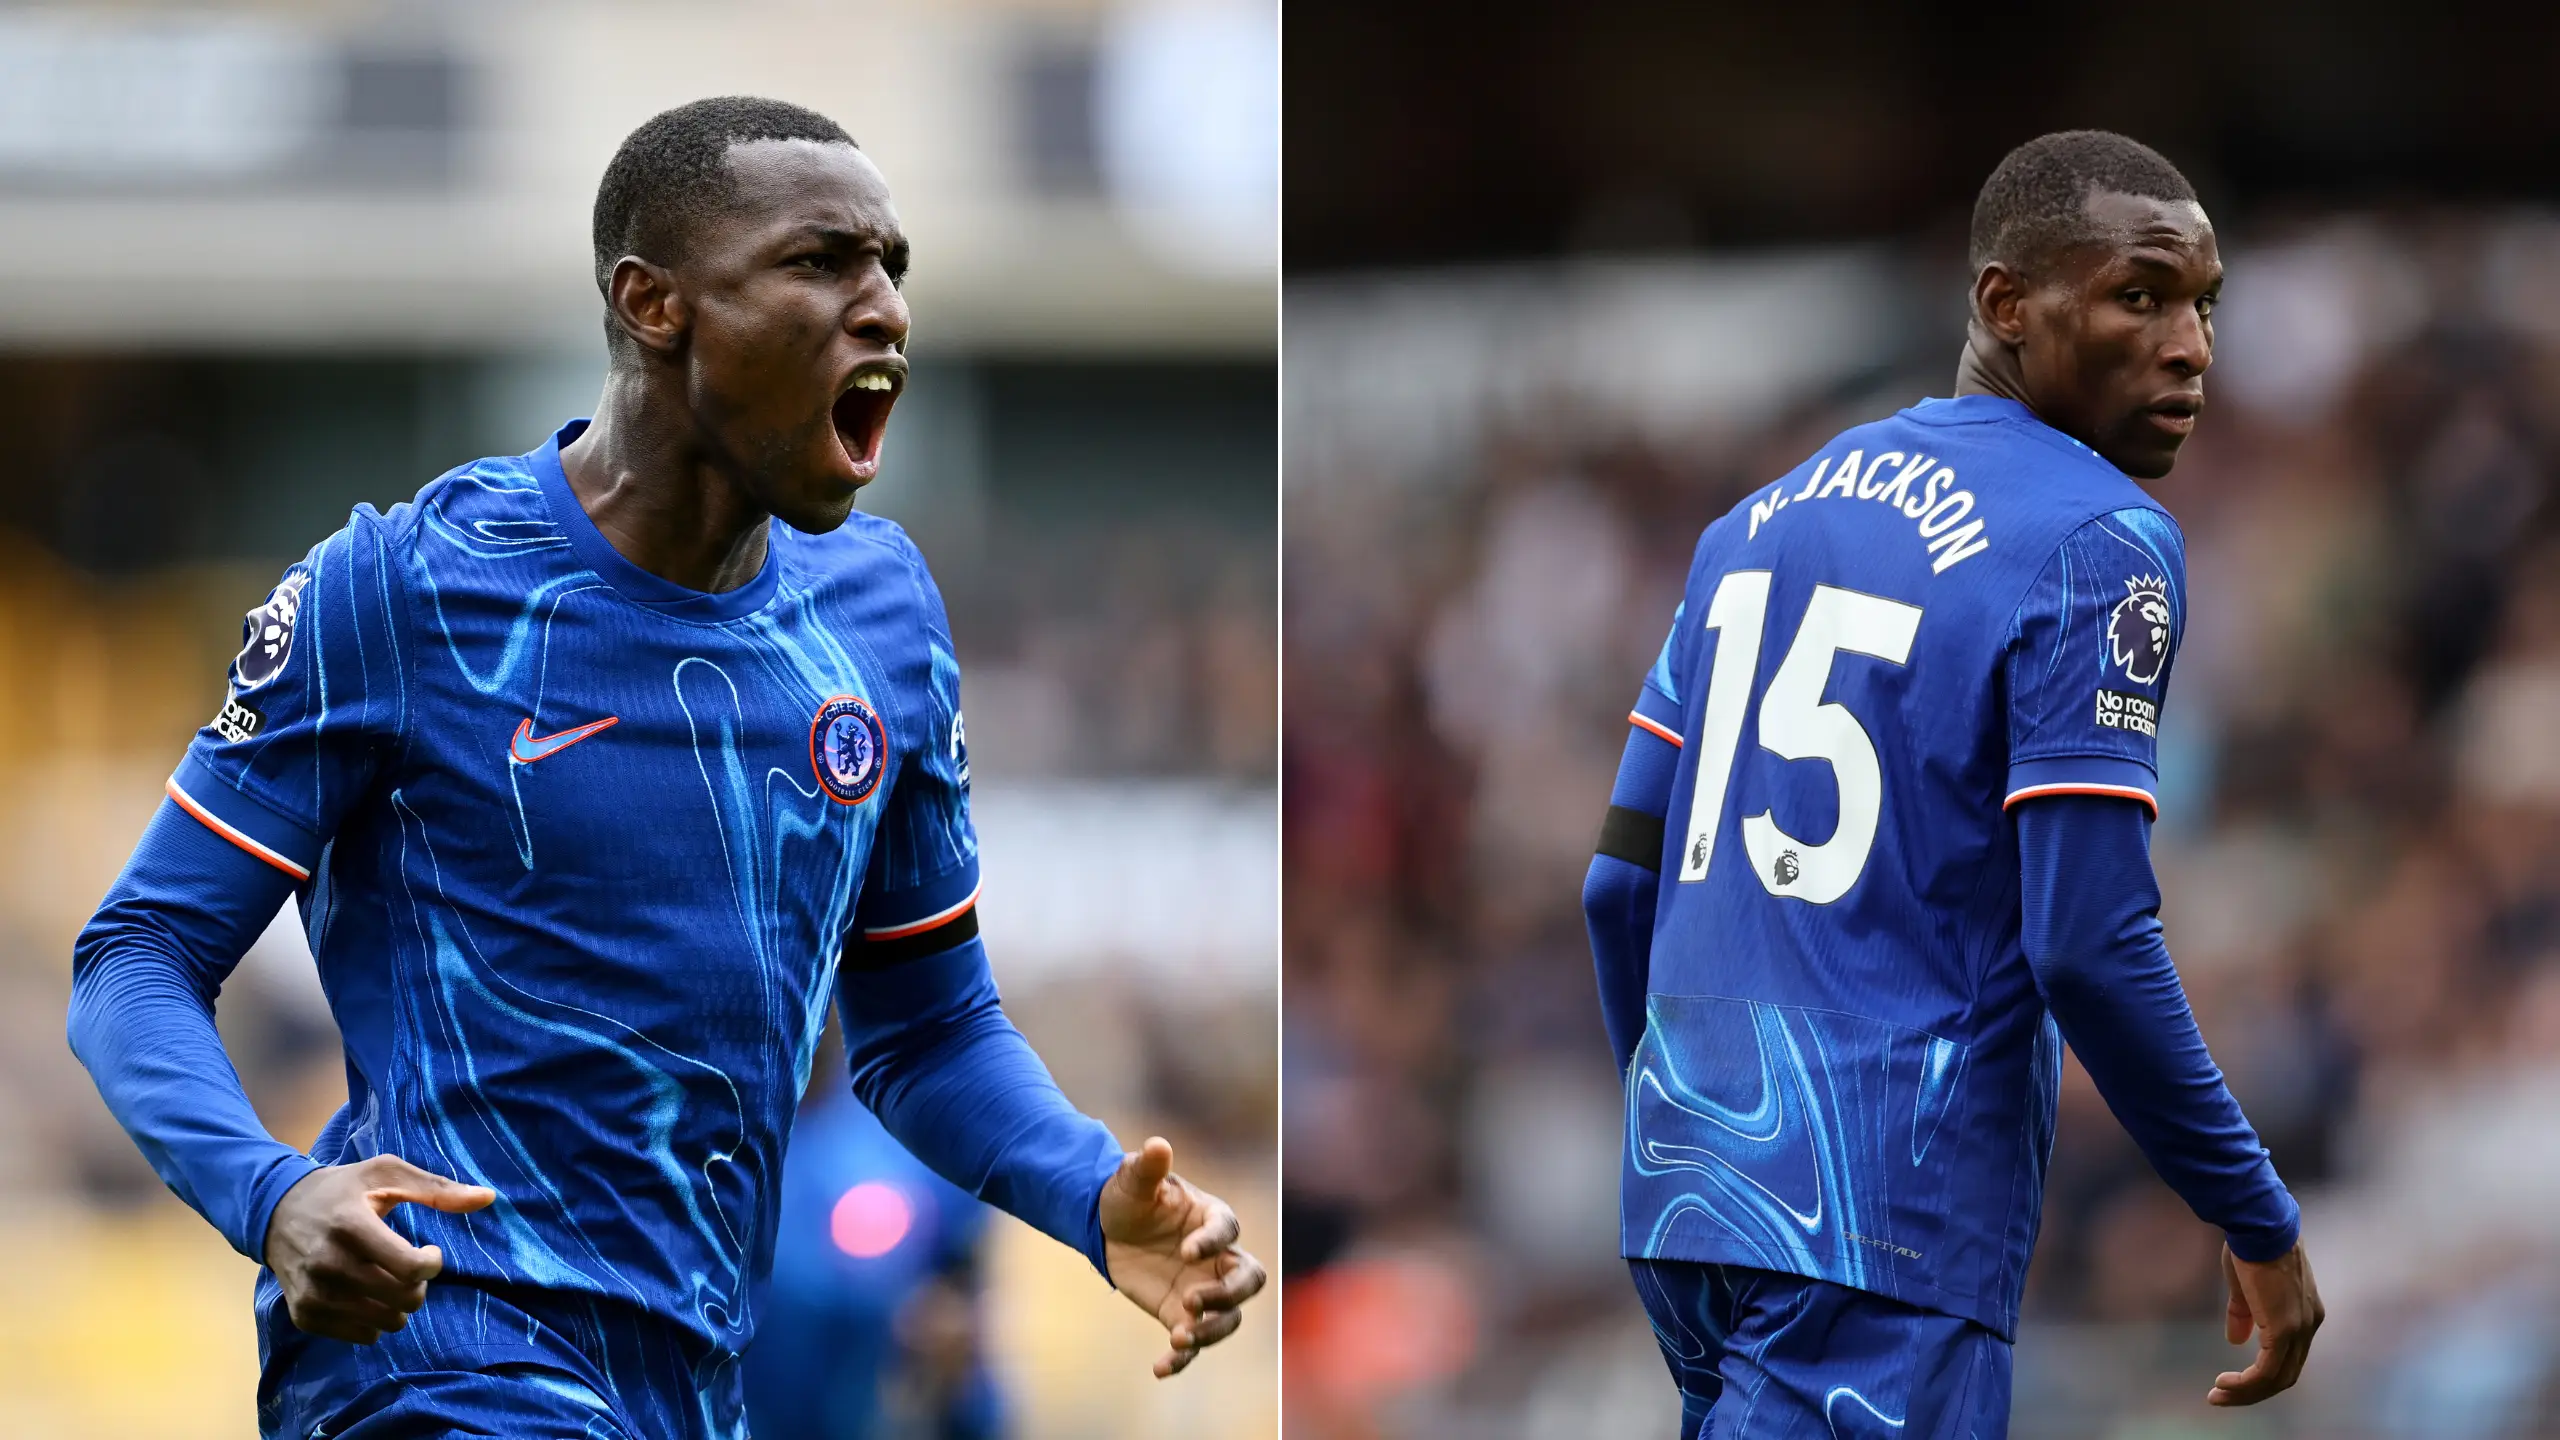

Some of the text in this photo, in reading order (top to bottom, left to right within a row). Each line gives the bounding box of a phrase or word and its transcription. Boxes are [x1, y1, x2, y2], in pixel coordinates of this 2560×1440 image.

[1749, 449, 1989, 577] N. JACKSON
[1678, 569, 1923, 905] 15
[2096, 689, 2155, 721] No room
